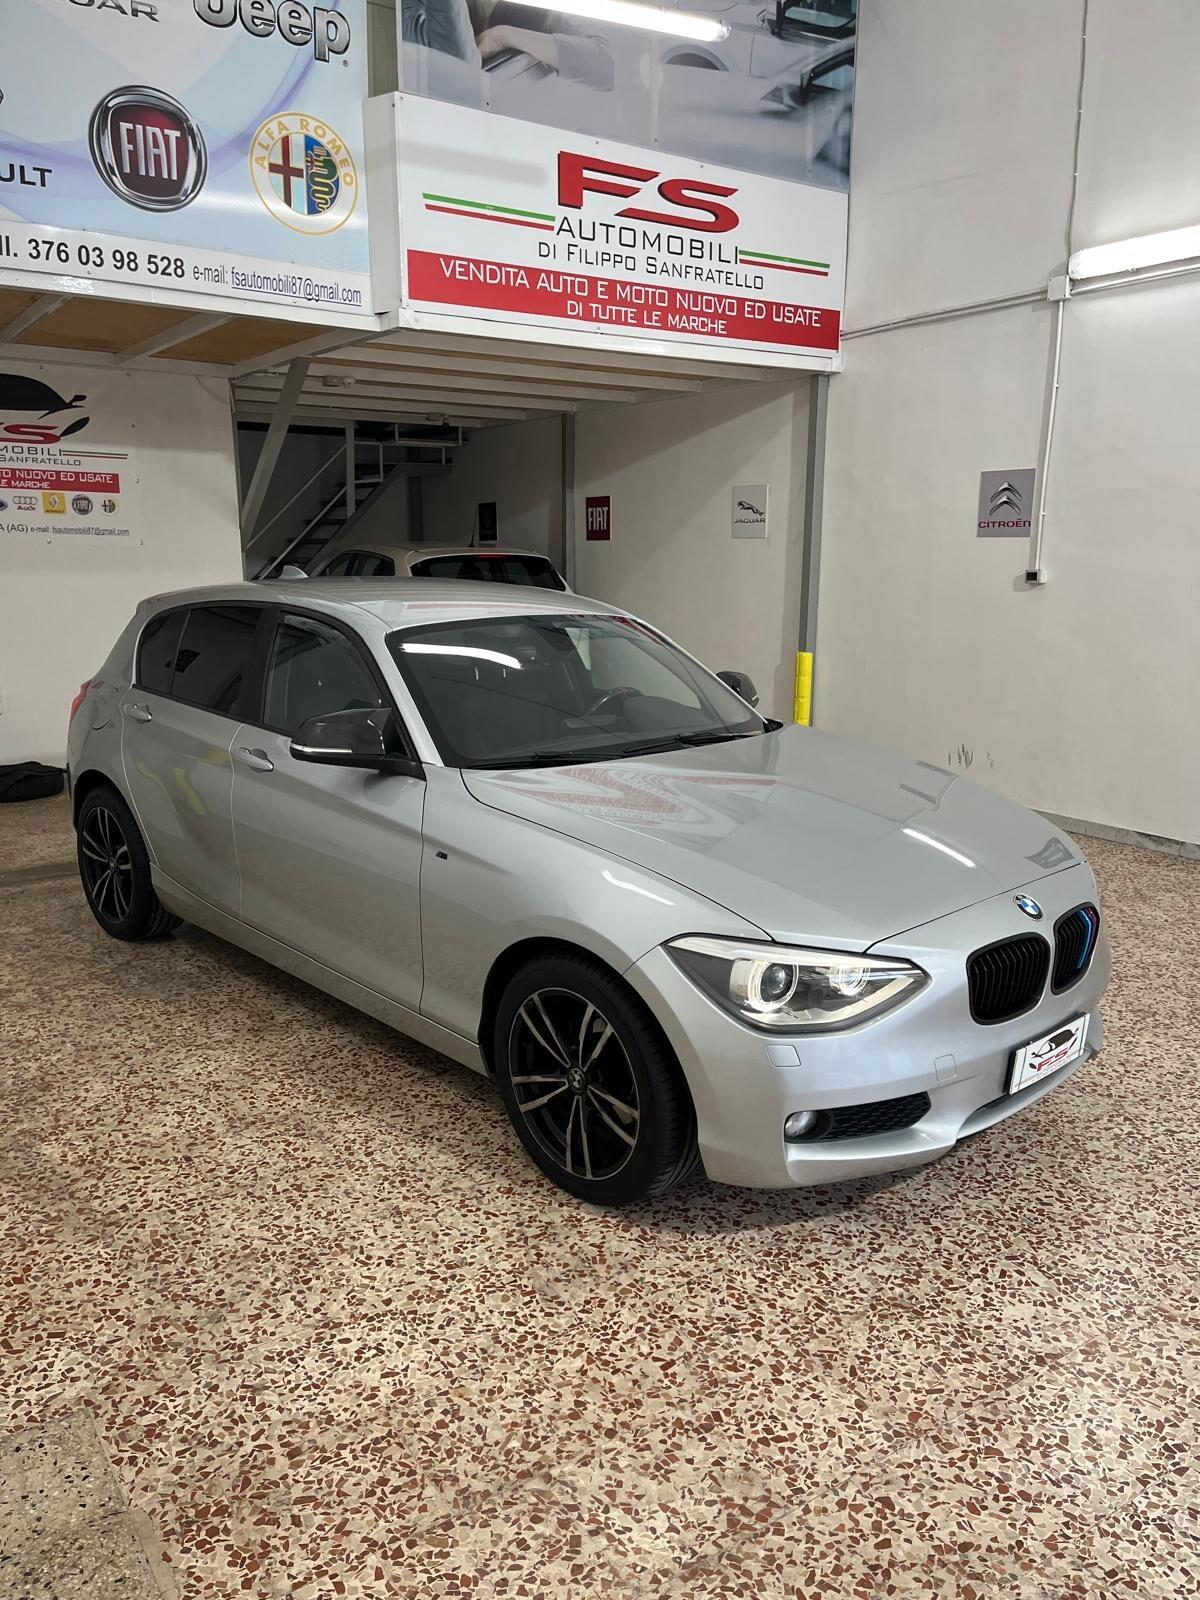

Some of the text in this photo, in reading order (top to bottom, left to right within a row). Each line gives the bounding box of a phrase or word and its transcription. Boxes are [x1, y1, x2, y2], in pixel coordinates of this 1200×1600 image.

[119, 121, 181, 181] FIAT
[255, 118, 354, 187] ALFA ROMEO
[557, 151, 740, 233] FS
[556, 216, 740, 266] AUTOMOBILI
[28, 238, 71, 264] 376
[78, 244, 105, 269] 03
[112, 249, 139, 273] 98
[147, 254, 186, 279] 528
[193, 264, 229, 285] e-mail:
[231, 266, 362, 306] fsautomobili87@gmail.com
[538, 242, 764, 291] DI FILIPPO SANFRATELLO
[439, 257, 822, 328] VENDITA AUTO E MOTO NUOVO ED USATE
[567, 300, 728, 335] DI TUTTE LE MARCHE
[0, 422, 61, 444] S
[12, 480, 51, 489] MARCHE
[16, 469, 56, 481] NUOVO
[60, 472, 76, 482] ED
[79, 473, 114, 484] USATE
[7, 523, 29, 534] (AG)
[587, 506, 609, 531] FIAT
[1037, 1047, 1068, 1072] FS
